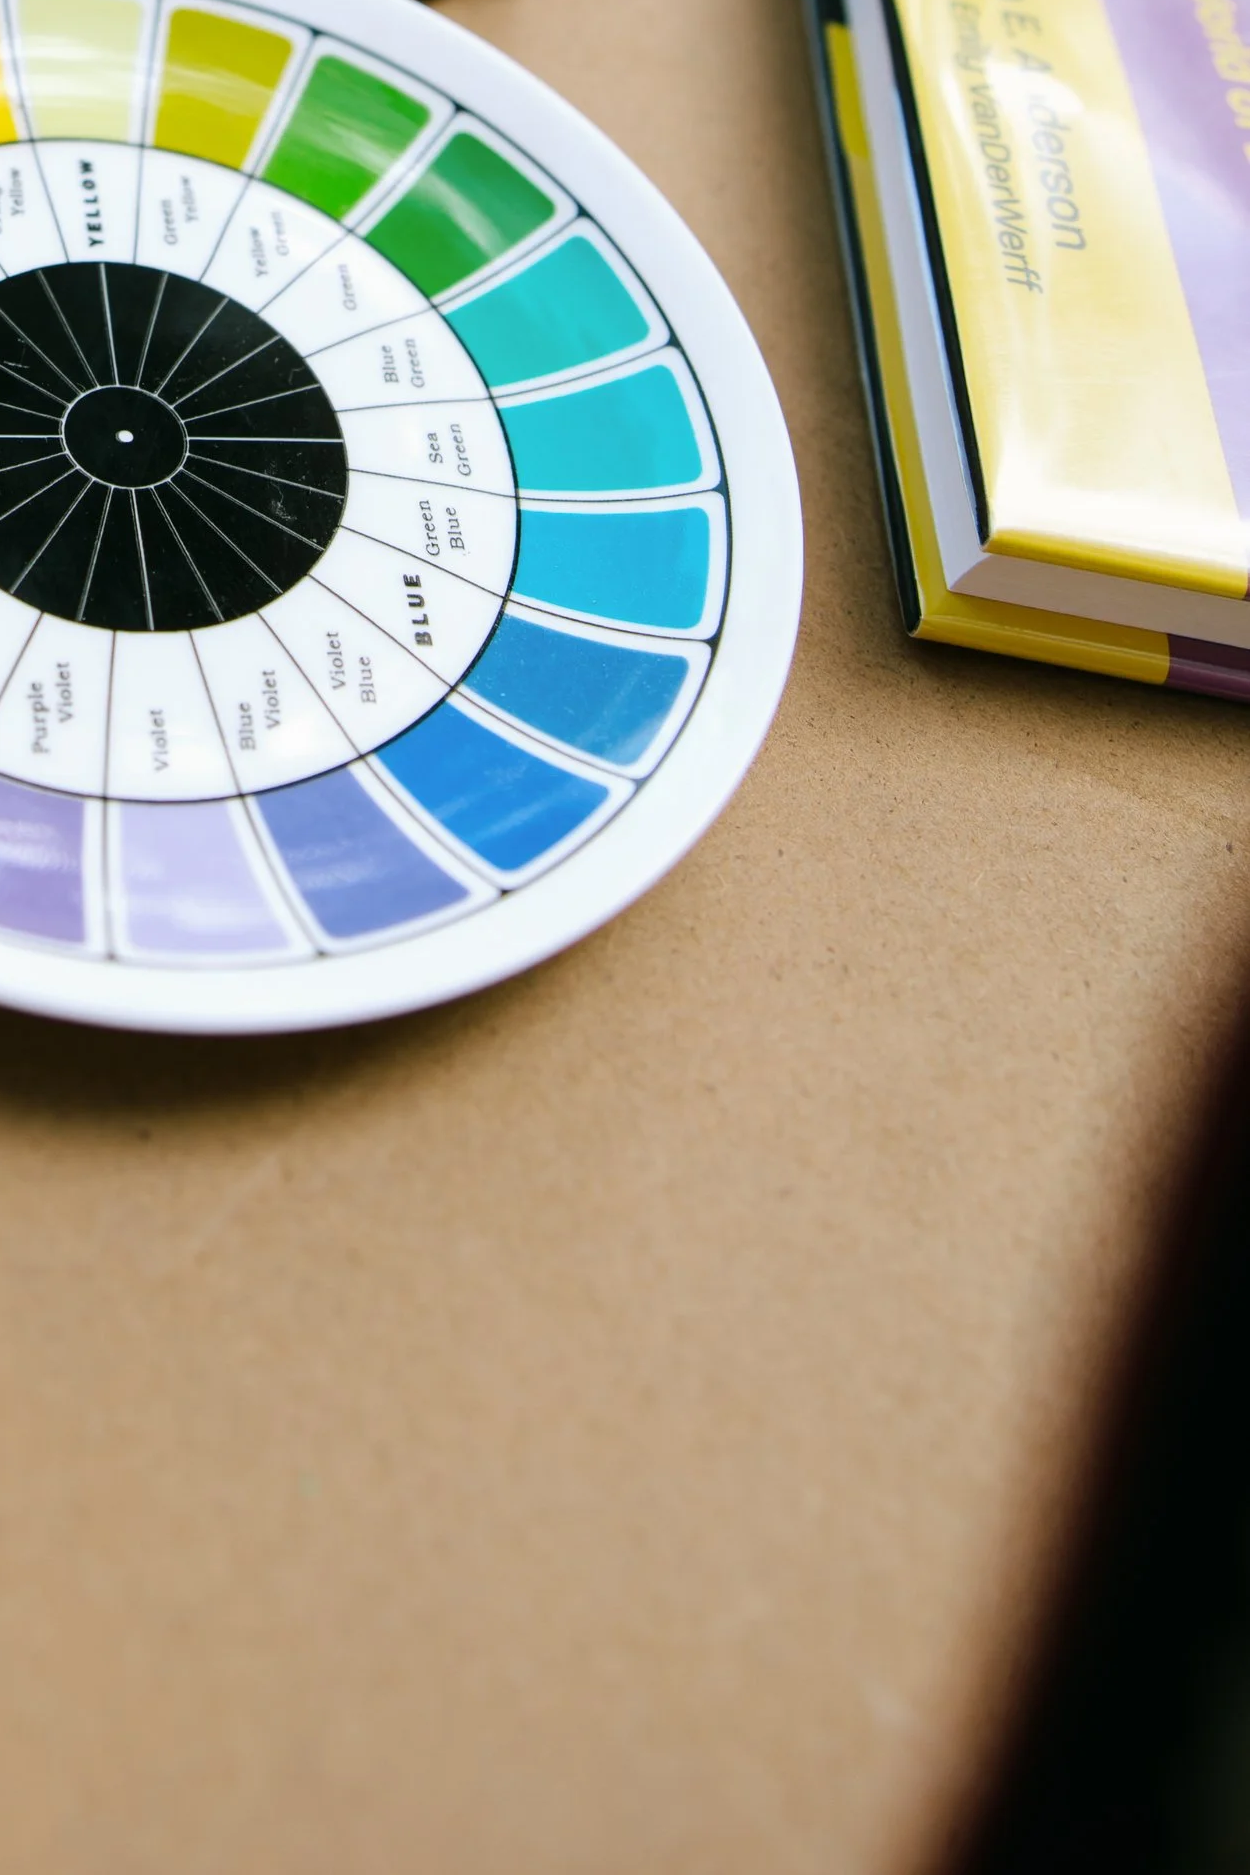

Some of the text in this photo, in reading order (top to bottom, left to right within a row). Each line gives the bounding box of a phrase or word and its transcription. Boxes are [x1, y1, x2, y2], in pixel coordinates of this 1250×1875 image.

[9, 167, 26, 217] Yellow
[79, 160, 105, 249] YELLOW
[181, 176, 199, 223] Yellow
[163, 199, 177, 245] Green
[271, 211, 290, 256] Green
[251, 227, 268, 279] Yellow
[338, 264, 357, 311] Green
[383, 345, 400, 384] Blue
[405, 338, 426, 388] Green
[429, 432, 444, 464] Sea
[450, 423, 472, 477] Green
[418, 500, 440, 557] Green
[449, 507, 465, 552] Blue
[402, 573, 433, 648] BLUE
[325, 631, 347, 691] Violet
[359, 656, 377, 705] Blue
[56, 662, 73, 723] Violet
[262, 669, 281, 730] Violet
[27, 682, 49, 754] Purple
[150, 708, 169, 772] Violet
[237, 701, 256, 751] Blue
